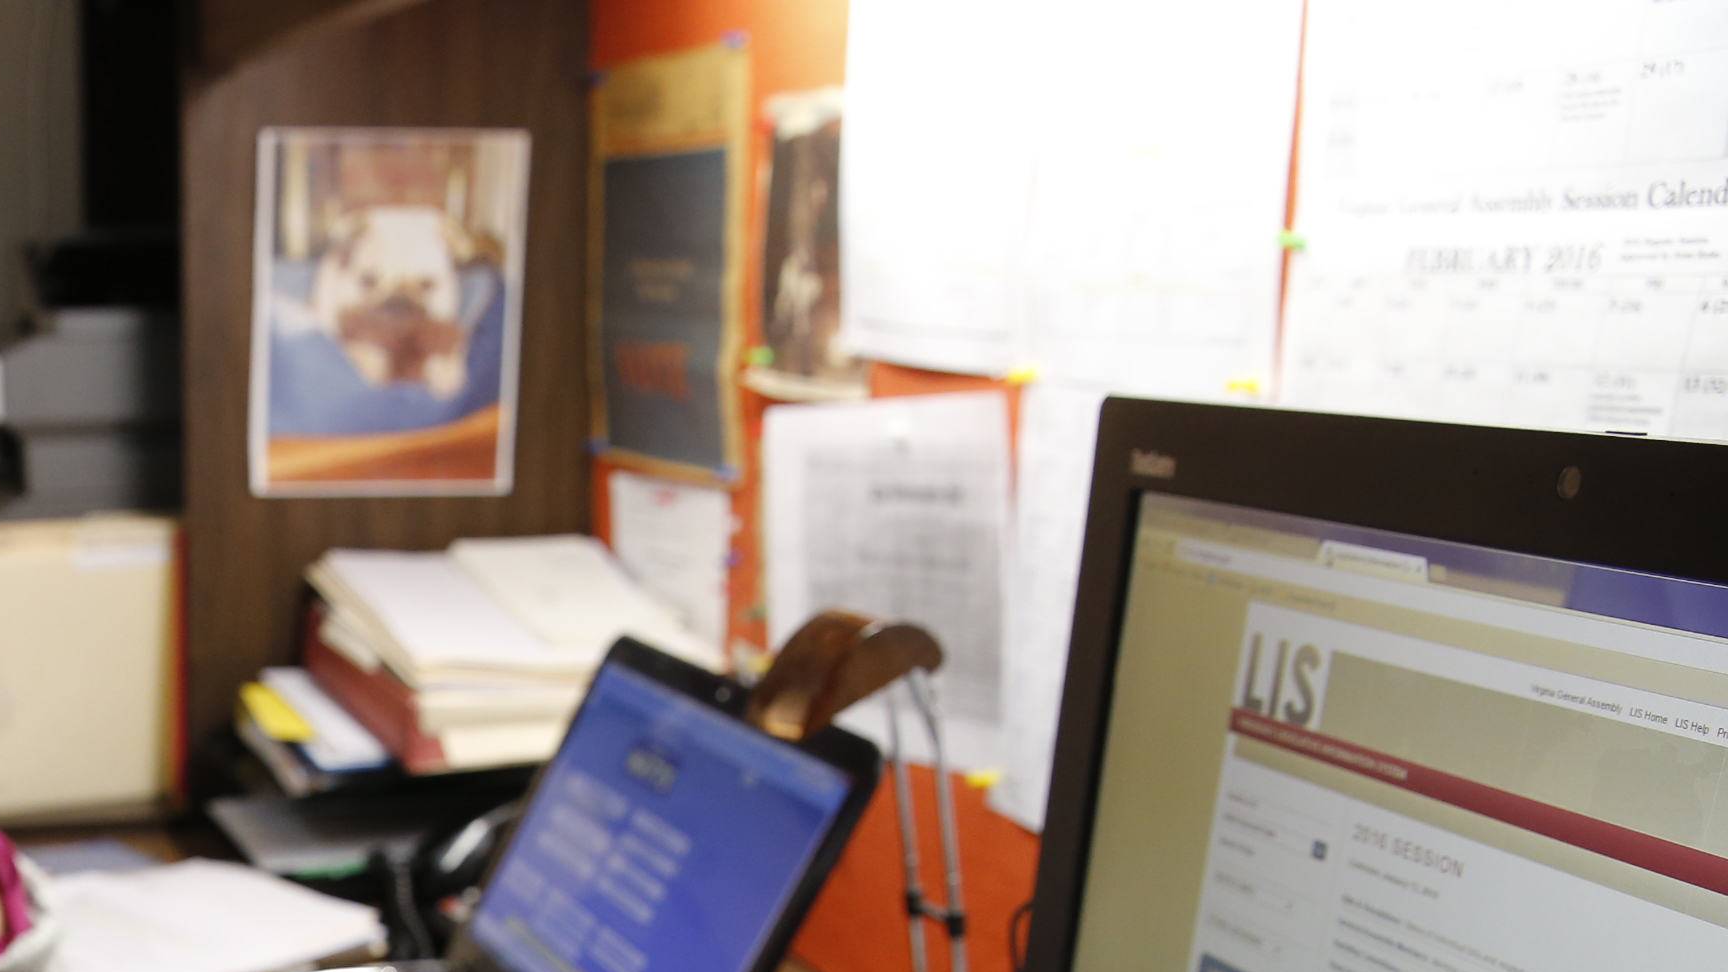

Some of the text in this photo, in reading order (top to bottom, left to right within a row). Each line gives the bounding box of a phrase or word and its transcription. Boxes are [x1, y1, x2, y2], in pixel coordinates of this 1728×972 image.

[1562, 184, 1641, 212] Session
[1405, 244, 1537, 276] FEBRUARY
[1543, 241, 1608, 275] 2016
[1240, 632, 1323, 730] LIS
[1557, 690, 1586, 704] General
[1586, 697, 1622, 715] Assembly
[1629, 707, 1643, 718] LIS
[1644, 711, 1668, 724] Home
[1675, 718, 1689, 729] LIS
[1690, 722, 1709, 736] Help
[1351, 823, 1463, 877] 2016 SESSION
